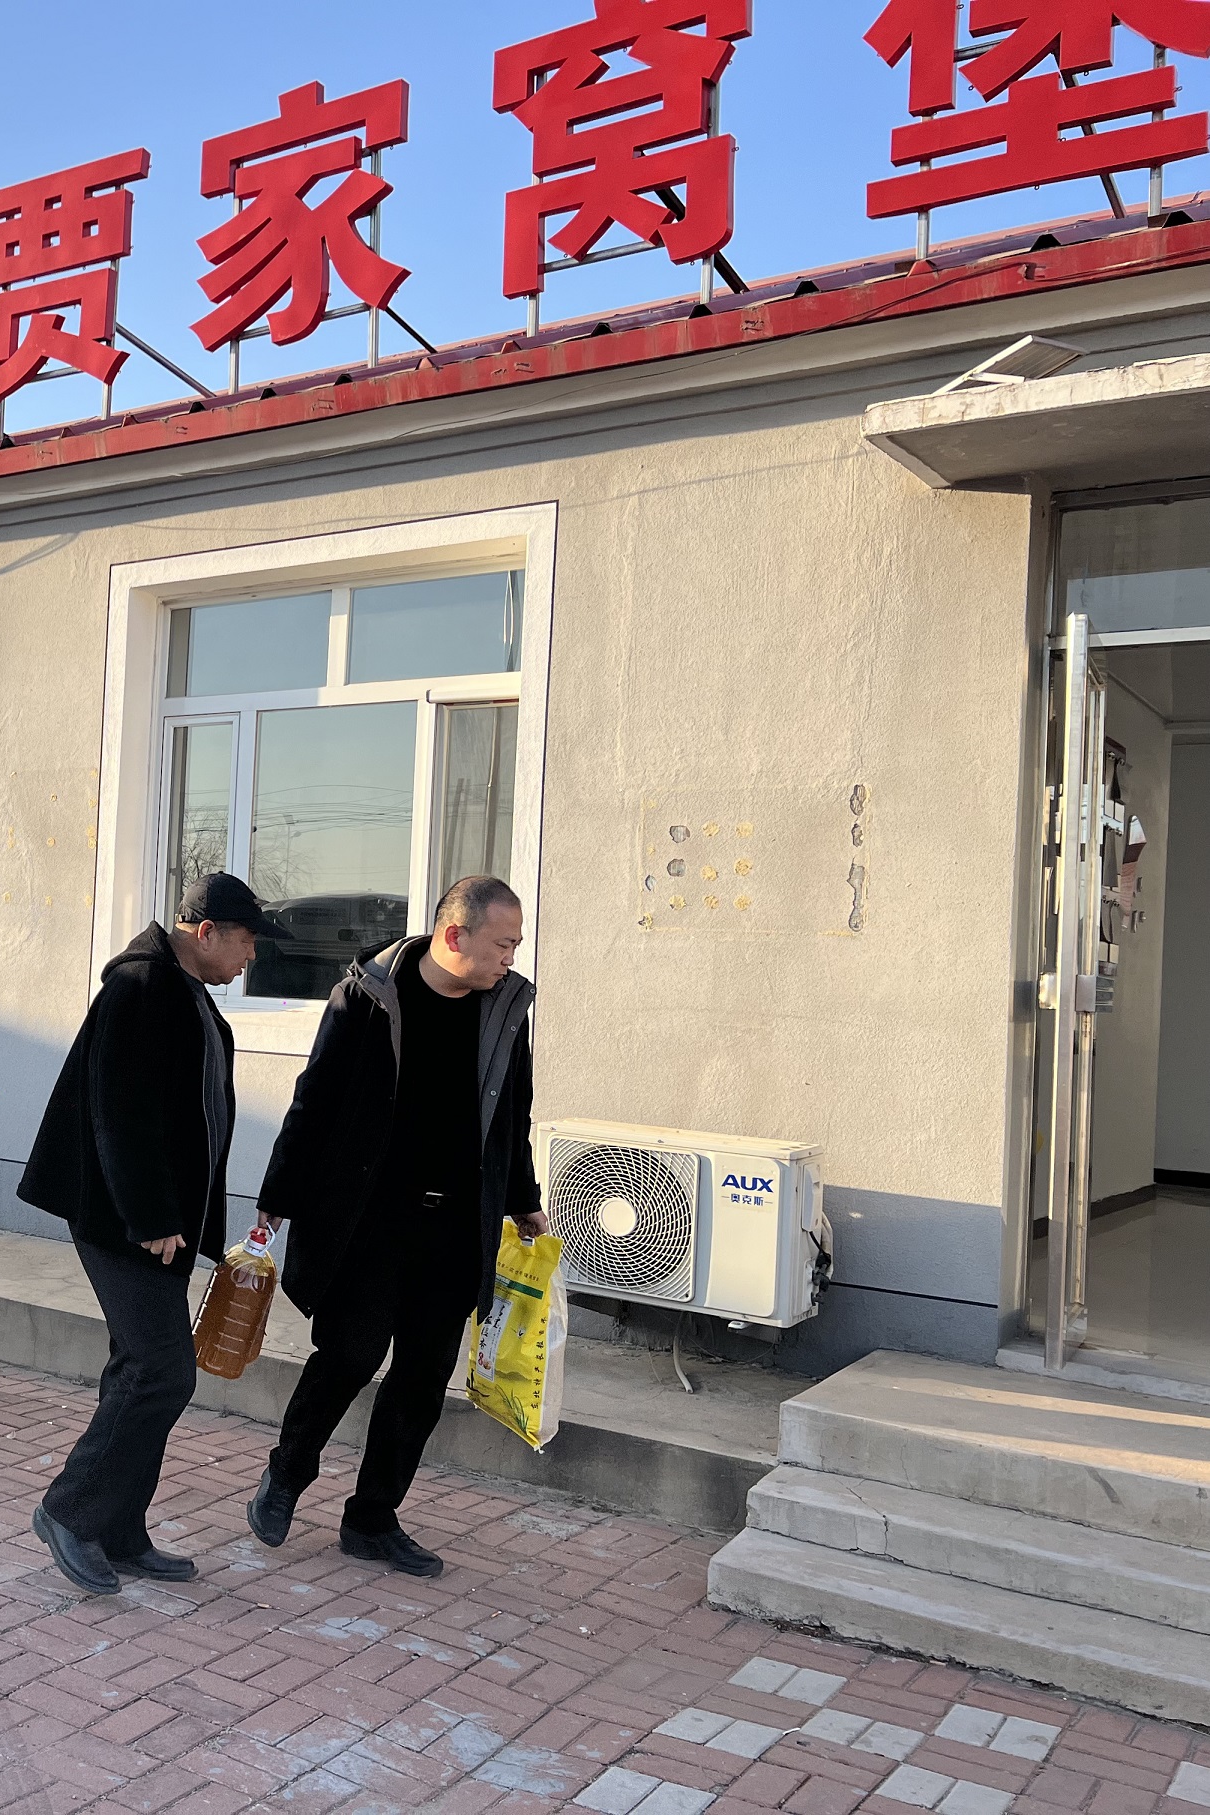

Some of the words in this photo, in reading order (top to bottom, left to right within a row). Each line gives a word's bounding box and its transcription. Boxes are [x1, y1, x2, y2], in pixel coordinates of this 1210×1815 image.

[721, 1174, 774, 1193] AUX
[730, 1193, 764, 1206] 奥克斯
